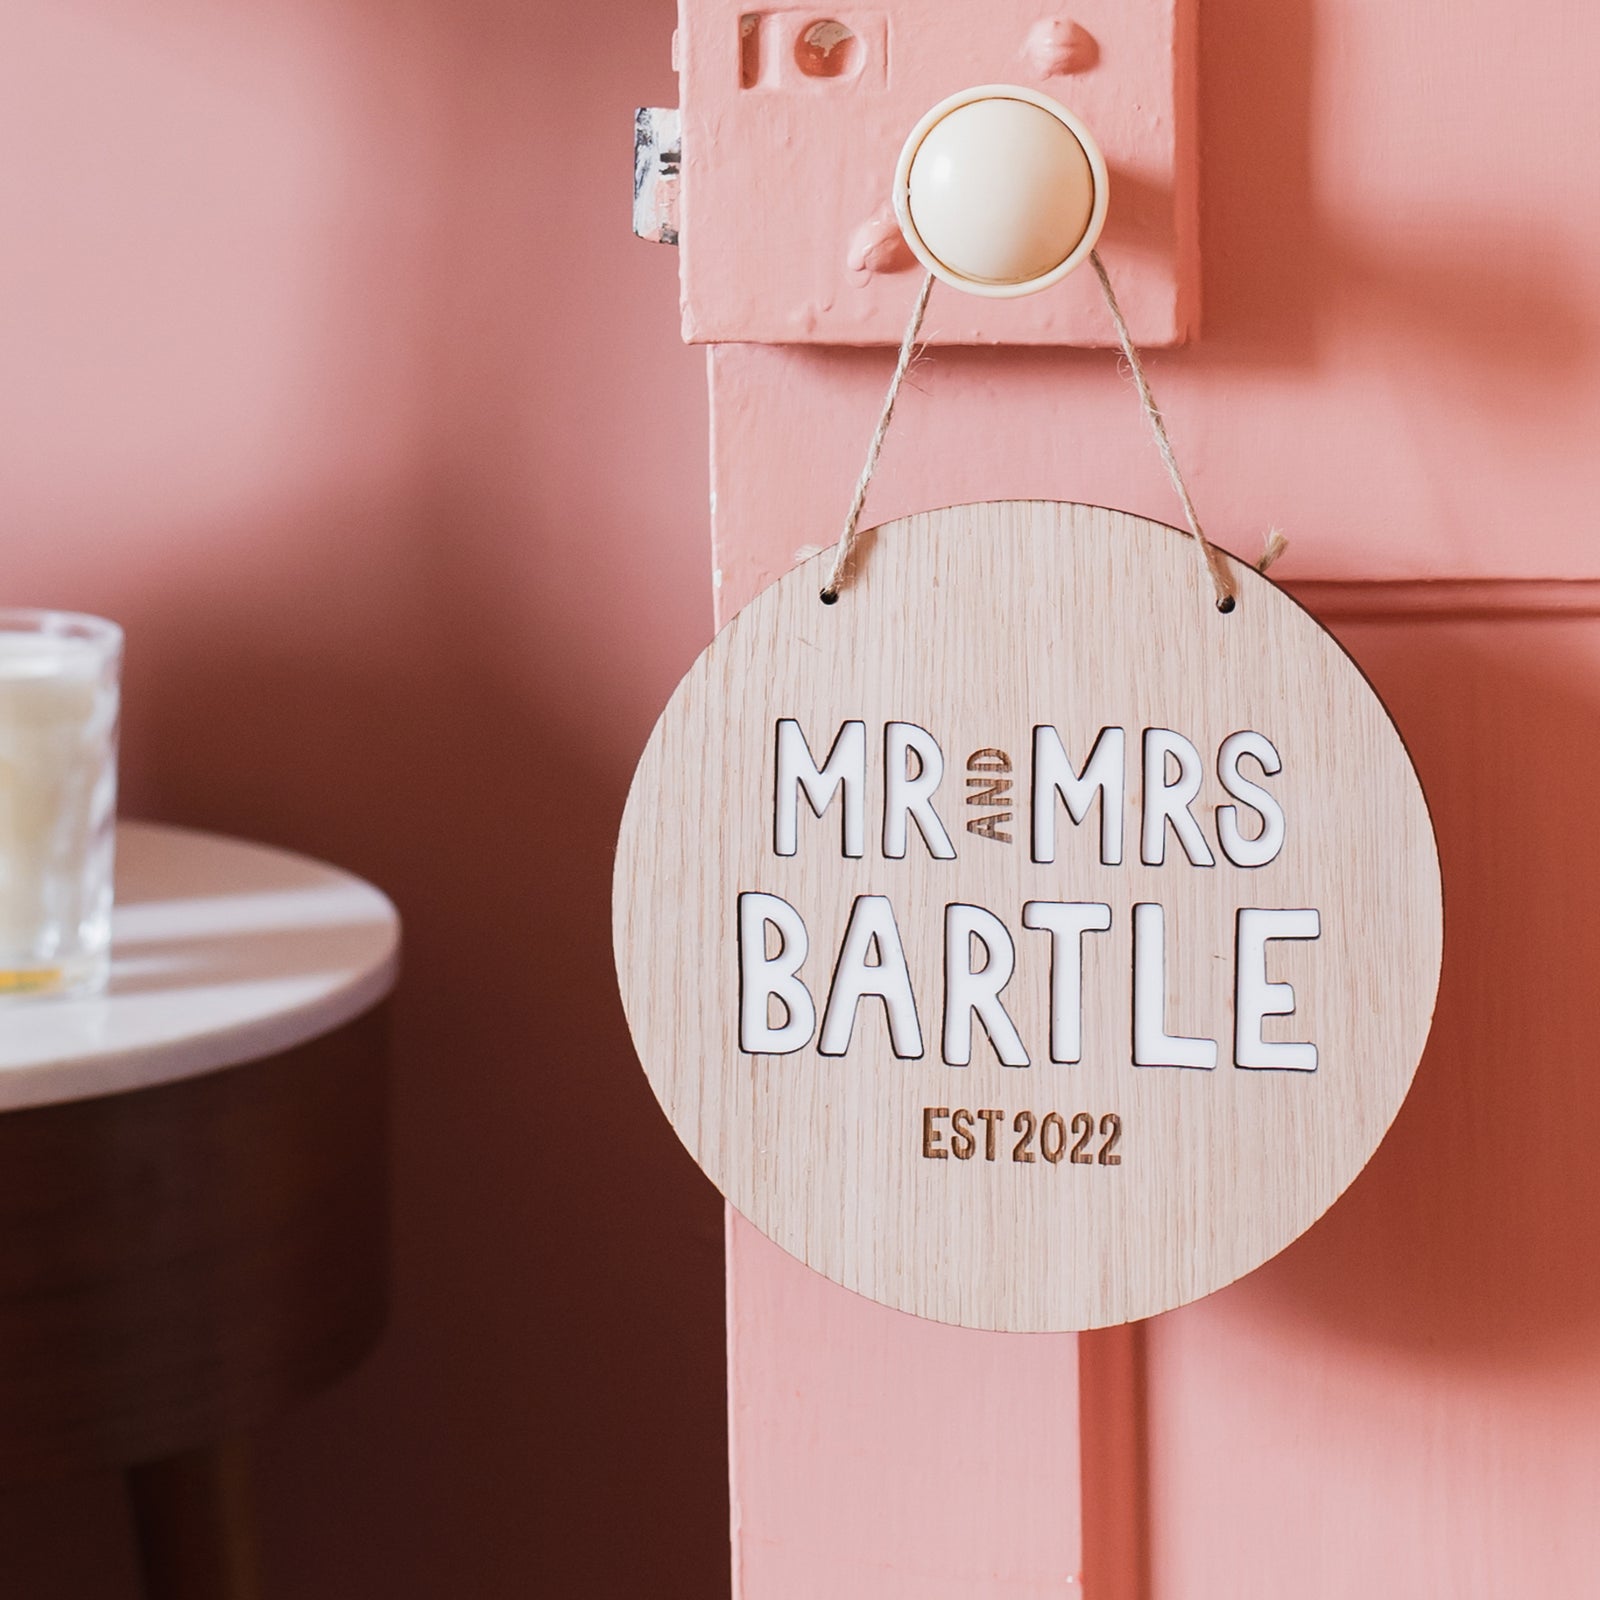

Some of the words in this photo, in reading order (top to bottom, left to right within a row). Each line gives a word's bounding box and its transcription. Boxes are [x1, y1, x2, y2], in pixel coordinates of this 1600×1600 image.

[773, 718, 957, 859] MR
[966, 747, 1013, 844] AND
[1030, 725, 1286, 868] MRS
[737, 891, 1321, 1072] BARTLE
[922, 1107, 1005, 1161] EST
[1013, 1110, 1122, 1166] 2022
